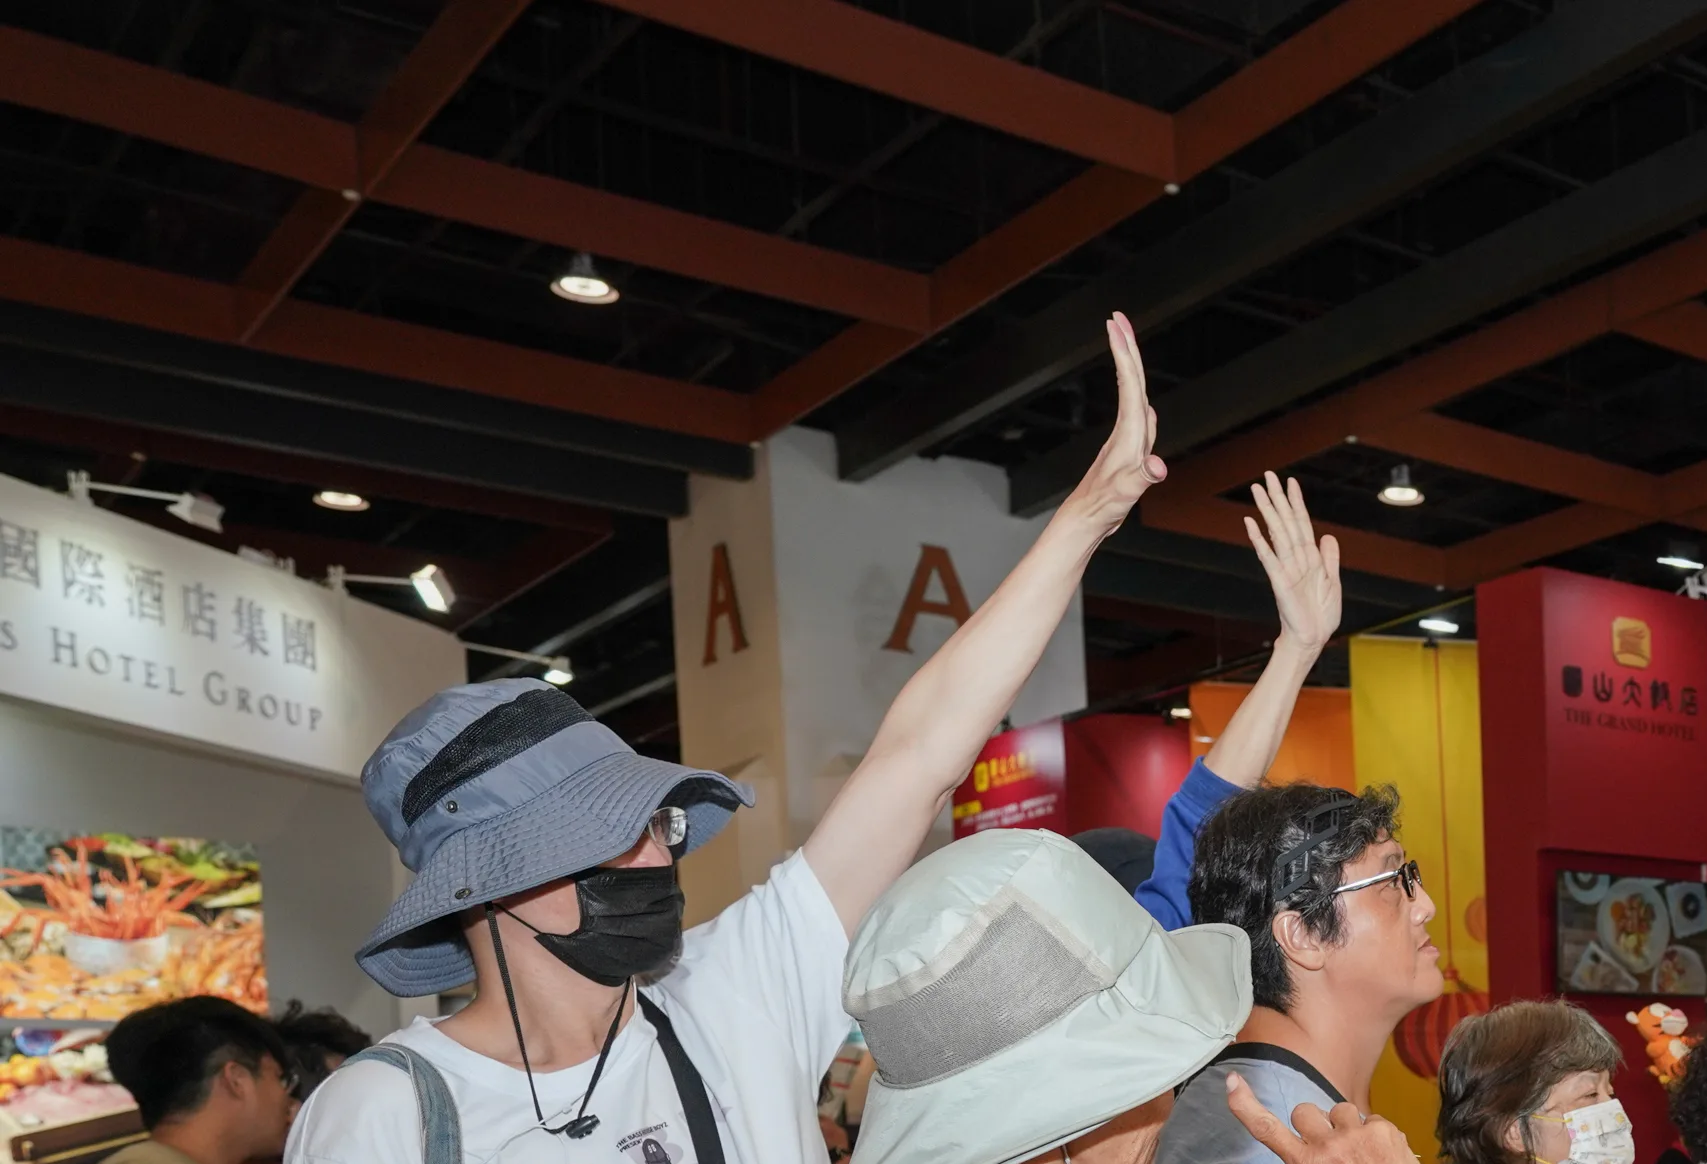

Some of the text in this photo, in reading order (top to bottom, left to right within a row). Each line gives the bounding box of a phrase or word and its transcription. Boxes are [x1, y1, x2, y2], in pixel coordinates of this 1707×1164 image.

[702, 542, 750, 667] A
[880, 541, 975, 655] A
[51, 625, 186, 697] HOTEL
[203, 671, 322, 731] GROUP
